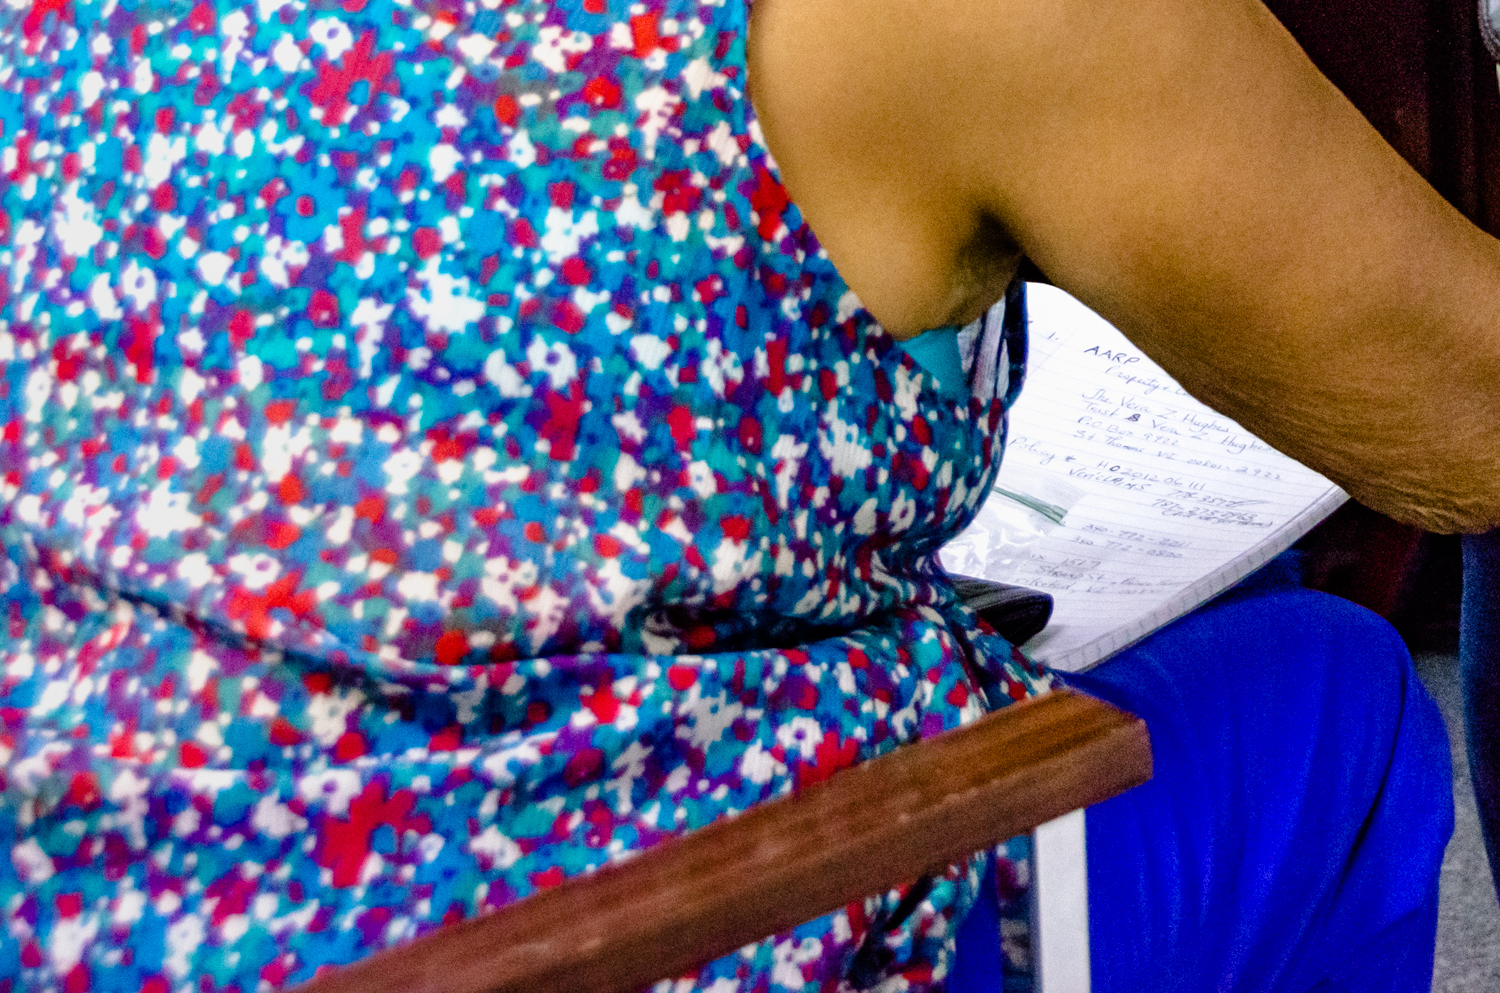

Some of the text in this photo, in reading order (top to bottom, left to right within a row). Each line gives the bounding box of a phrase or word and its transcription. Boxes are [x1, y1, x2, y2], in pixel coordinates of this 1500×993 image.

[1083, 345, 1141, 365] AARP
[1081, 388, 1113, 405] The
[1119, 396, 1150, 413] Vera
[1082, 399, 1120, 417] Trust
[1151, 419, 1182, 437] Vera
[1106, 424, 1134, 437] Box
[1007, 436, 1056, 466] Policy
